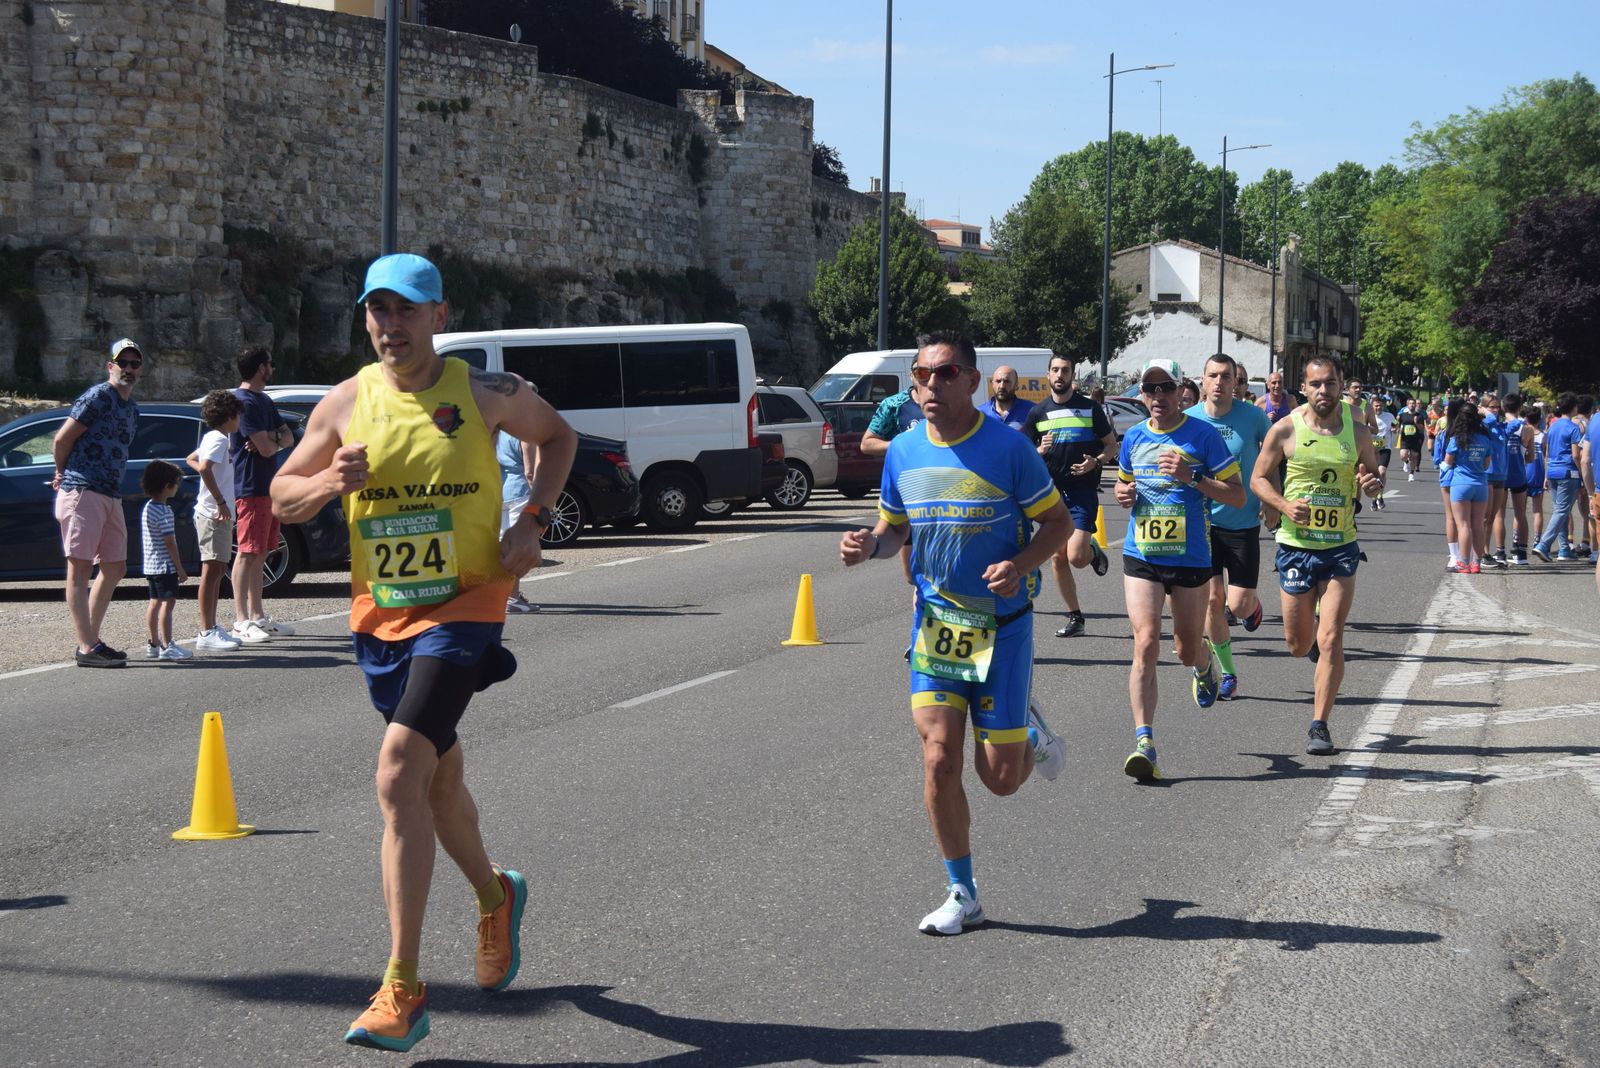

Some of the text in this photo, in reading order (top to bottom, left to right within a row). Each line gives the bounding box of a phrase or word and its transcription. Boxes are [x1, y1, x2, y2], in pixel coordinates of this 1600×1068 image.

[403, 482, 480, 498] VALORIO
[398, 502, 435, 512] ZAMORA
[384, 514, 438, 528] FUNDACION
[386, 523, 439, 536] CAJA RURAL
[1139, 519, 1178, 540] 162
[375, 537, 447, 578] 224
[392, 584, 453, 600] CAJA RURAL
[943, 615, 961, 624] CAJA
[944, 608, 988, 622] FUNDACION
[935, 627, 974, 659] 85
[932, 663, 953, 674] CAJA
